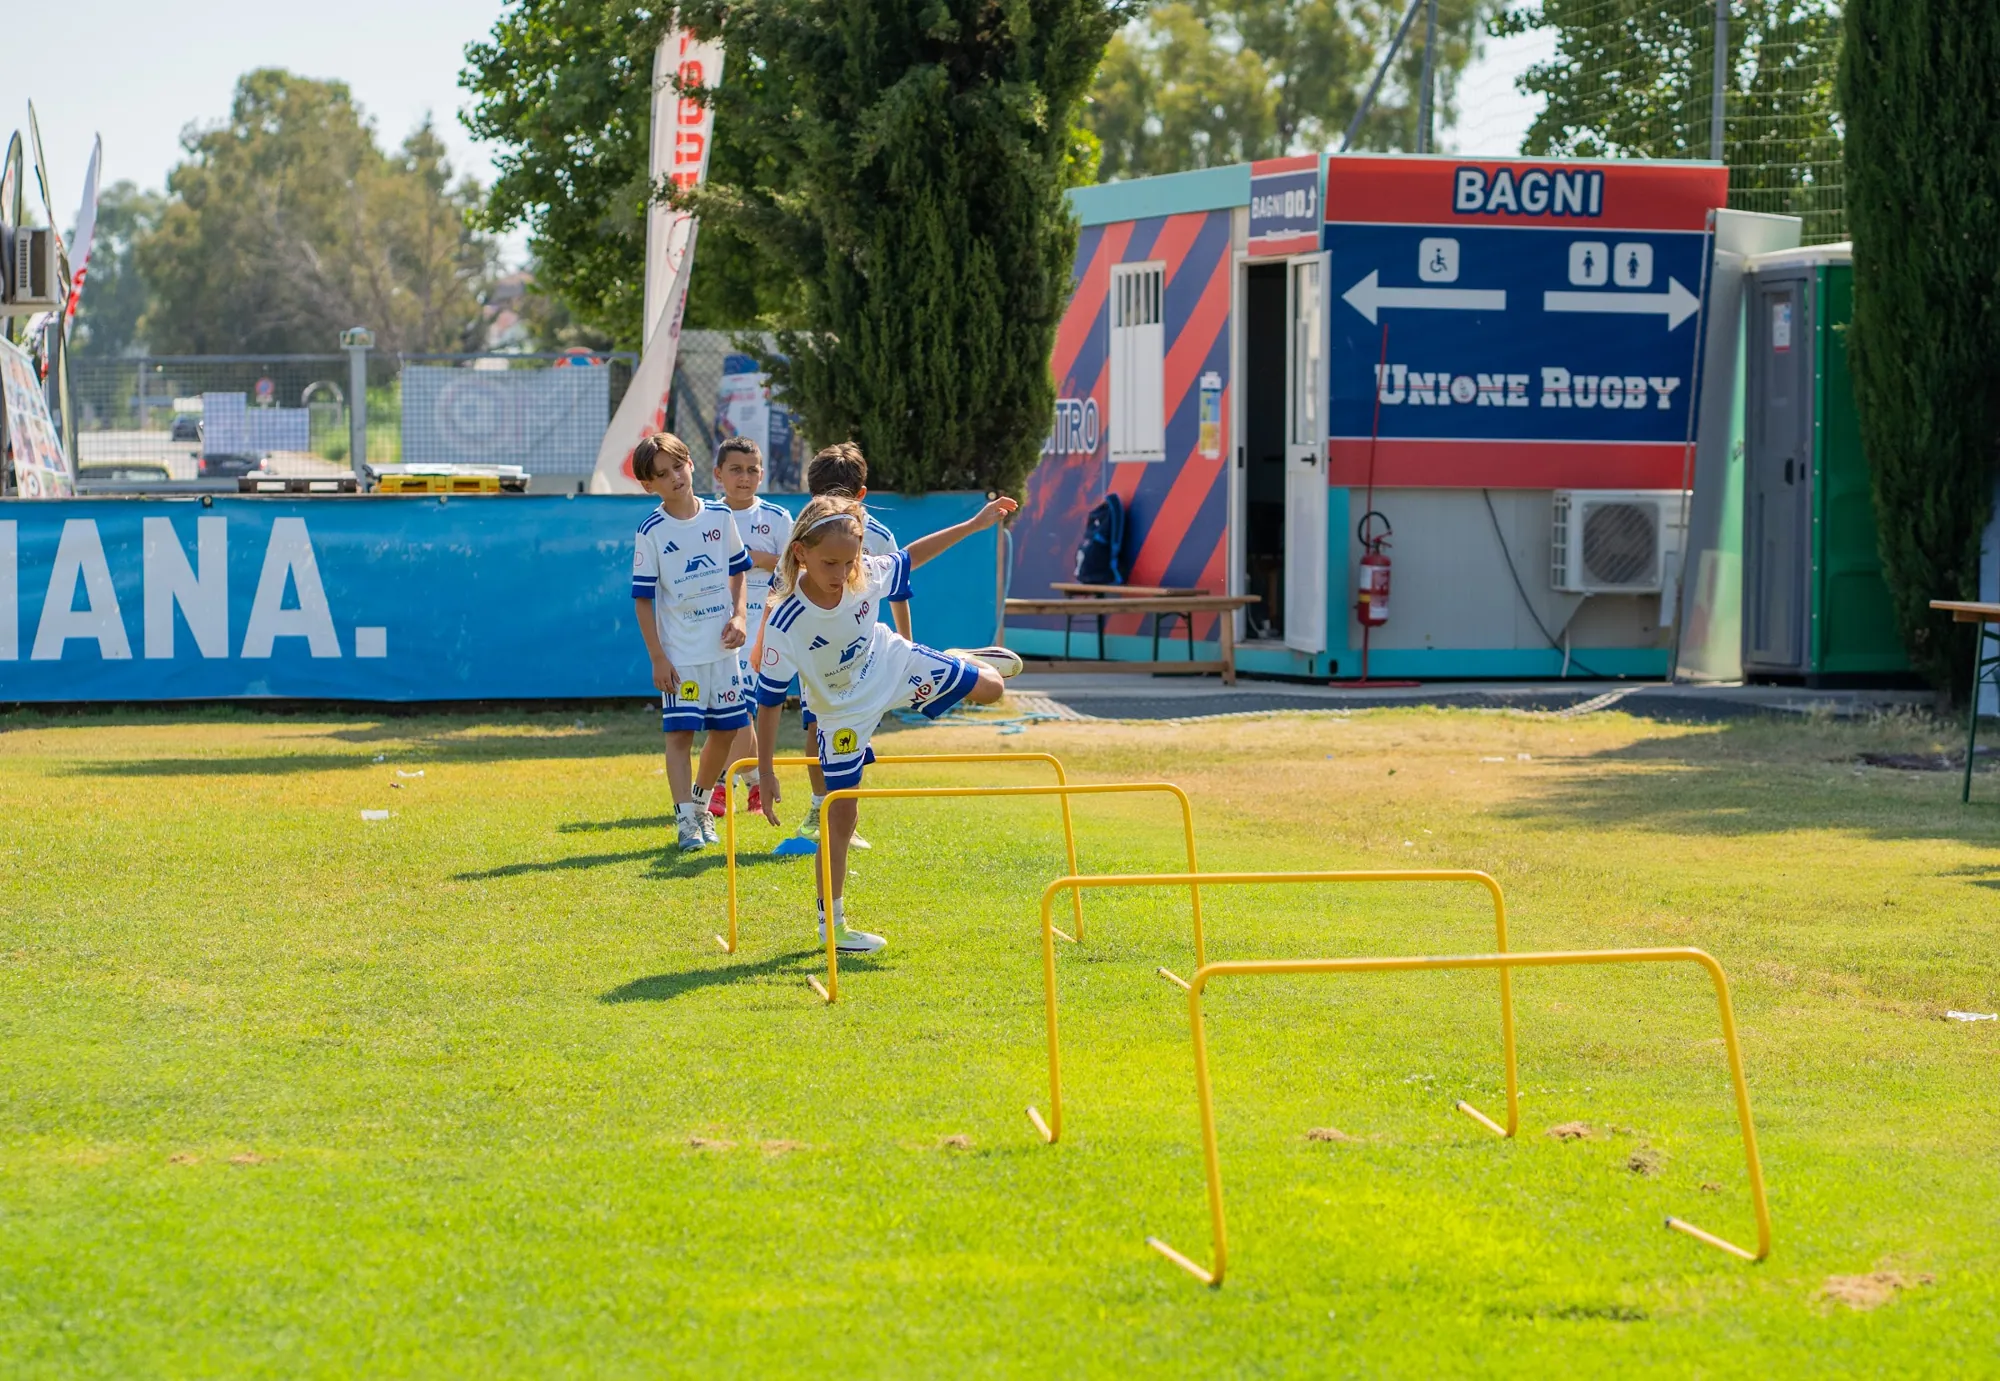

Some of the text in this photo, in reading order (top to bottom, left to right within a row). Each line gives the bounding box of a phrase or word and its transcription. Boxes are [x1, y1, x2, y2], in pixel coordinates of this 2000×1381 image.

[1455, 168, 1602, 214] BAGNI
[1252, 194, 1284, 219] BAGNI
[1540, 366, 1681, 410] RUGBY
[731, 675, 740, 686] 84
[908, 675, 923, 687] 76
